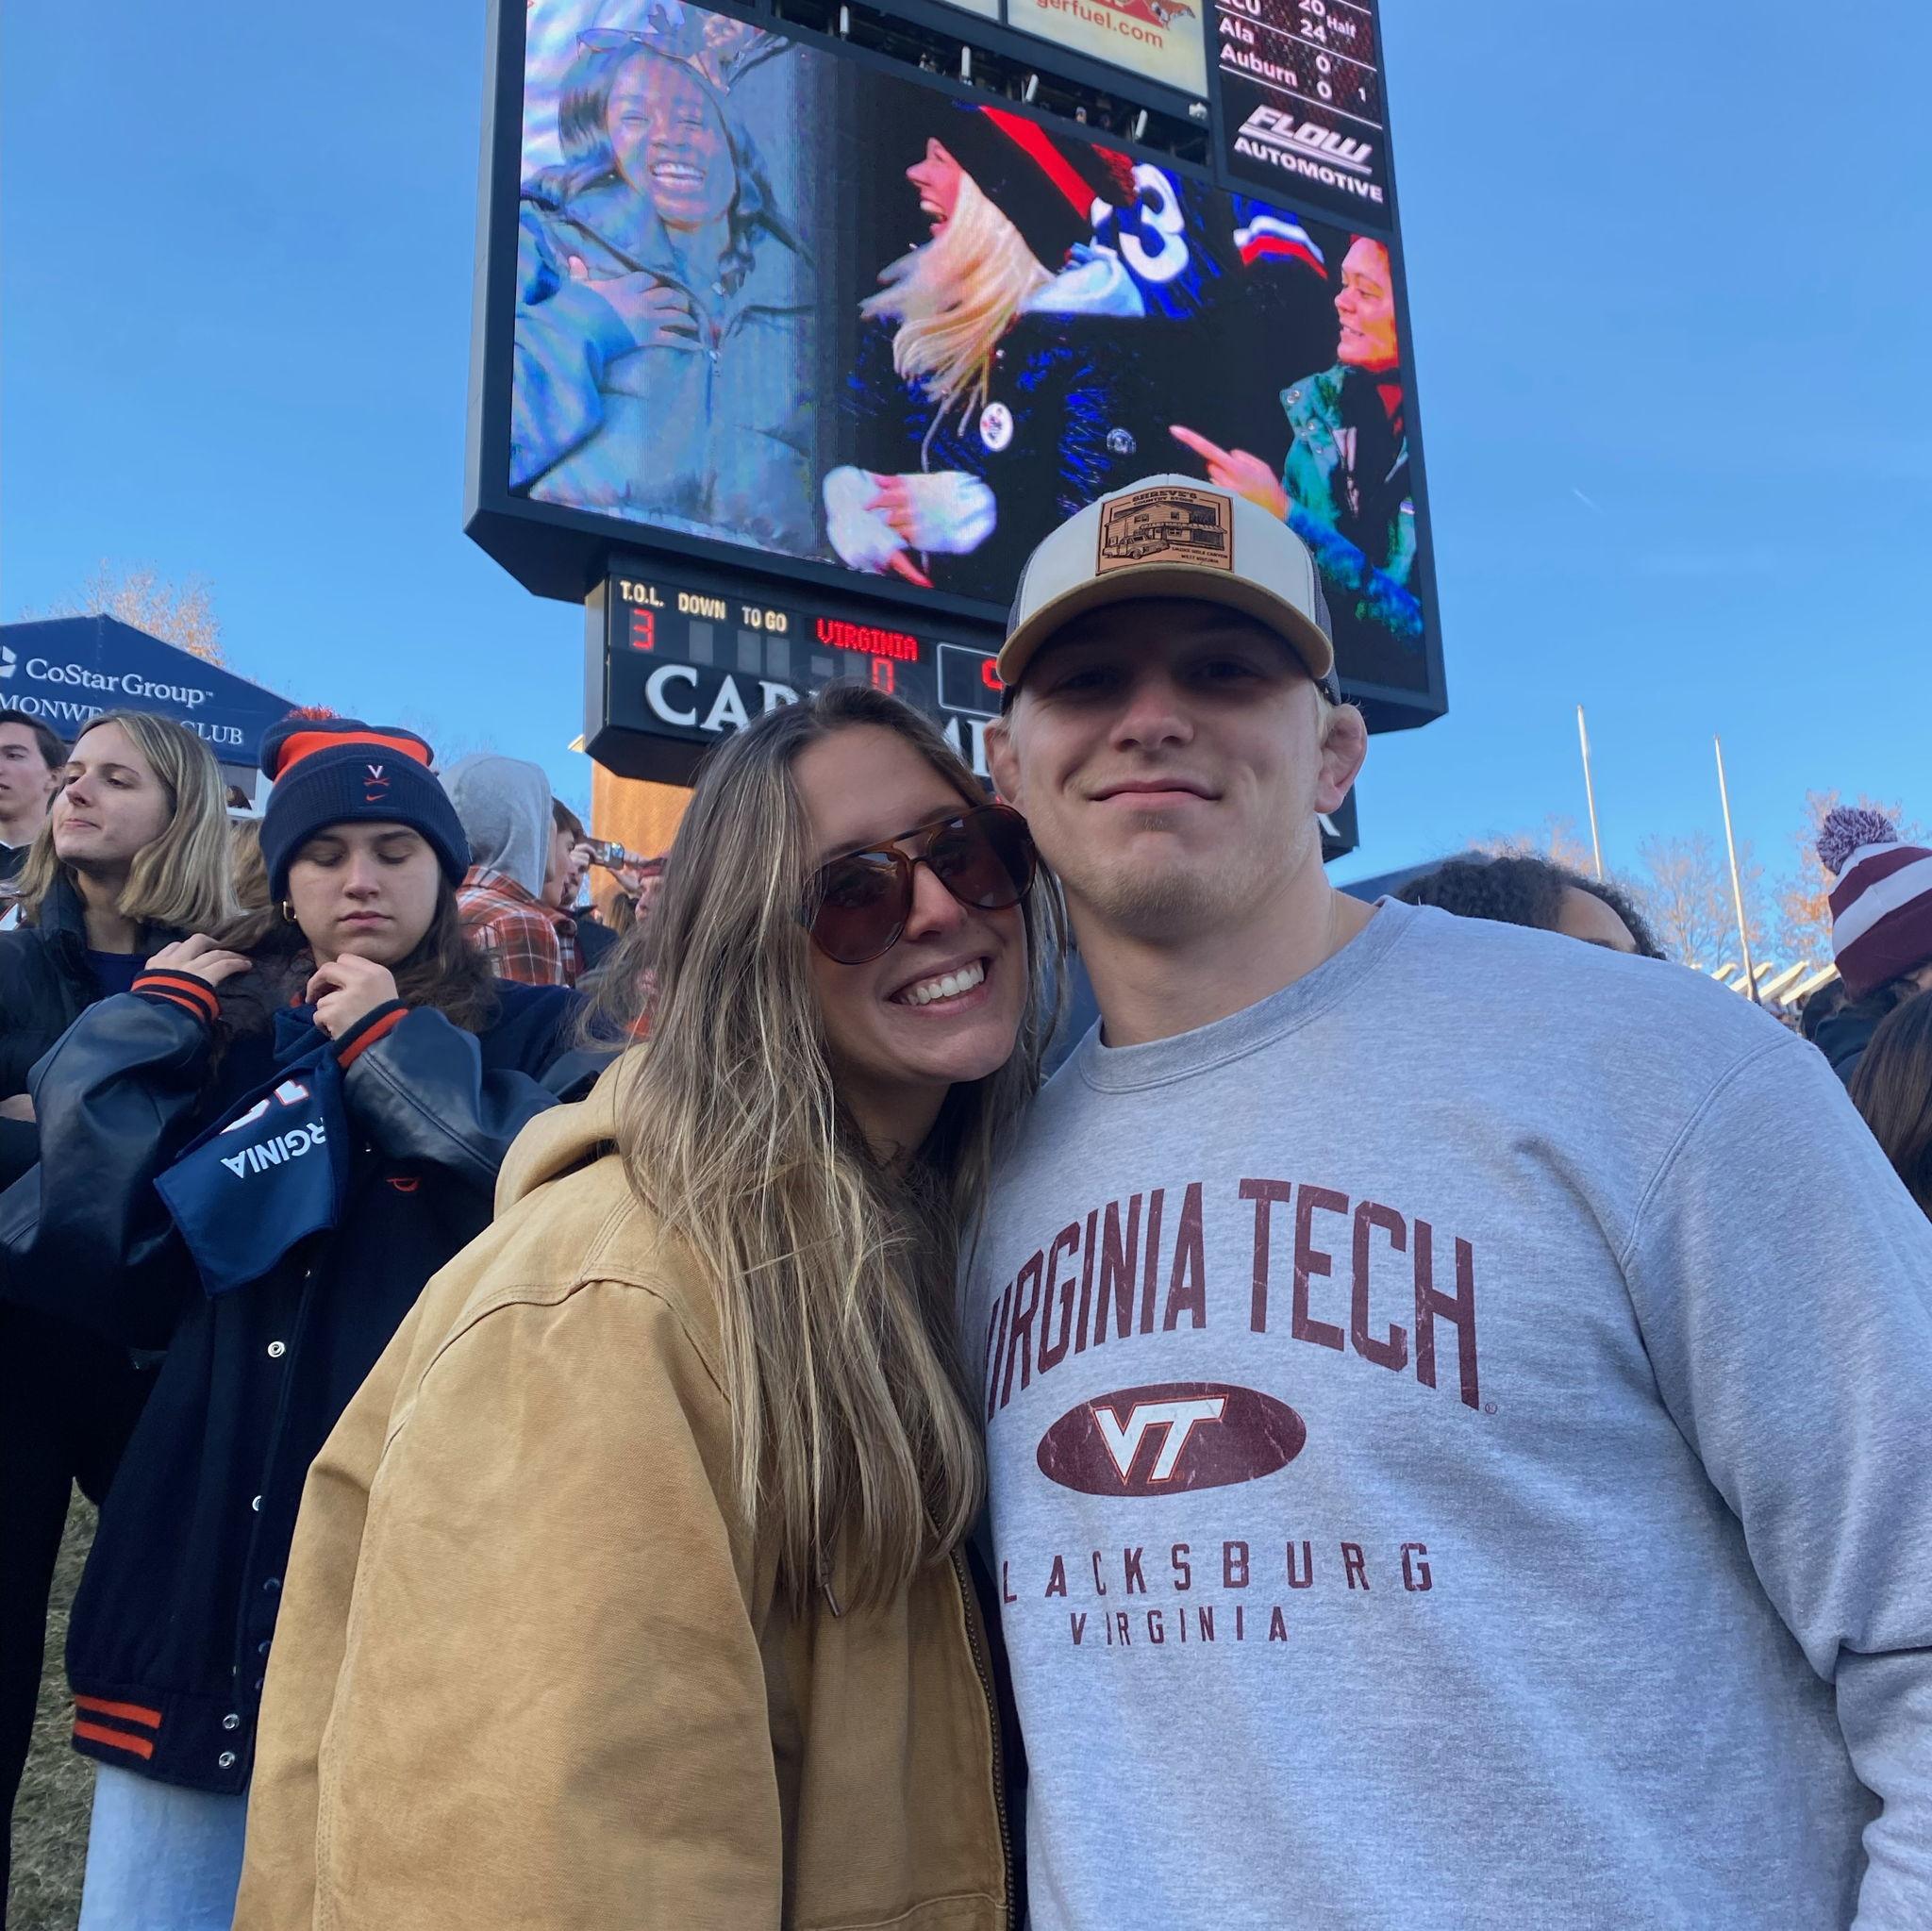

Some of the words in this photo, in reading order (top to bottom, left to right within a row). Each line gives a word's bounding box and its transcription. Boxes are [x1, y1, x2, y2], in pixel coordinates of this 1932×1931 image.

[1219, 17, 1255, 44] Ala
[1315, 55, 1331, 75] 0
[1300, 19, 1326, 43] 24
[1326, 15, 1357, 38] Half
[1220, 43, 1298, 87] Auburn
[1316, 81, 1332, 101] 0
[1357, 87, 1366, 103] 1
[1243, 104, 1373, 166] FLOW
[1234, 137, 1384, 204] AUTOMOTIVE
[620, 579, 664, 607] T.O.L.
[677, 591, 726, 619] DOWN
[741, 606, 761, 627] TO
[764, 609, 787, 632] GO
[633, 608, 655, 651] 3
[815, 618, 919, 661] VIRGINIA
[25, 658, 119, 691] CoStar
[1238, 1178, 1480, 1411] TECH
[1091, 1394, 1229, 1486] VT
[1070, 1606, 1289, 1646] VIRGINIA
